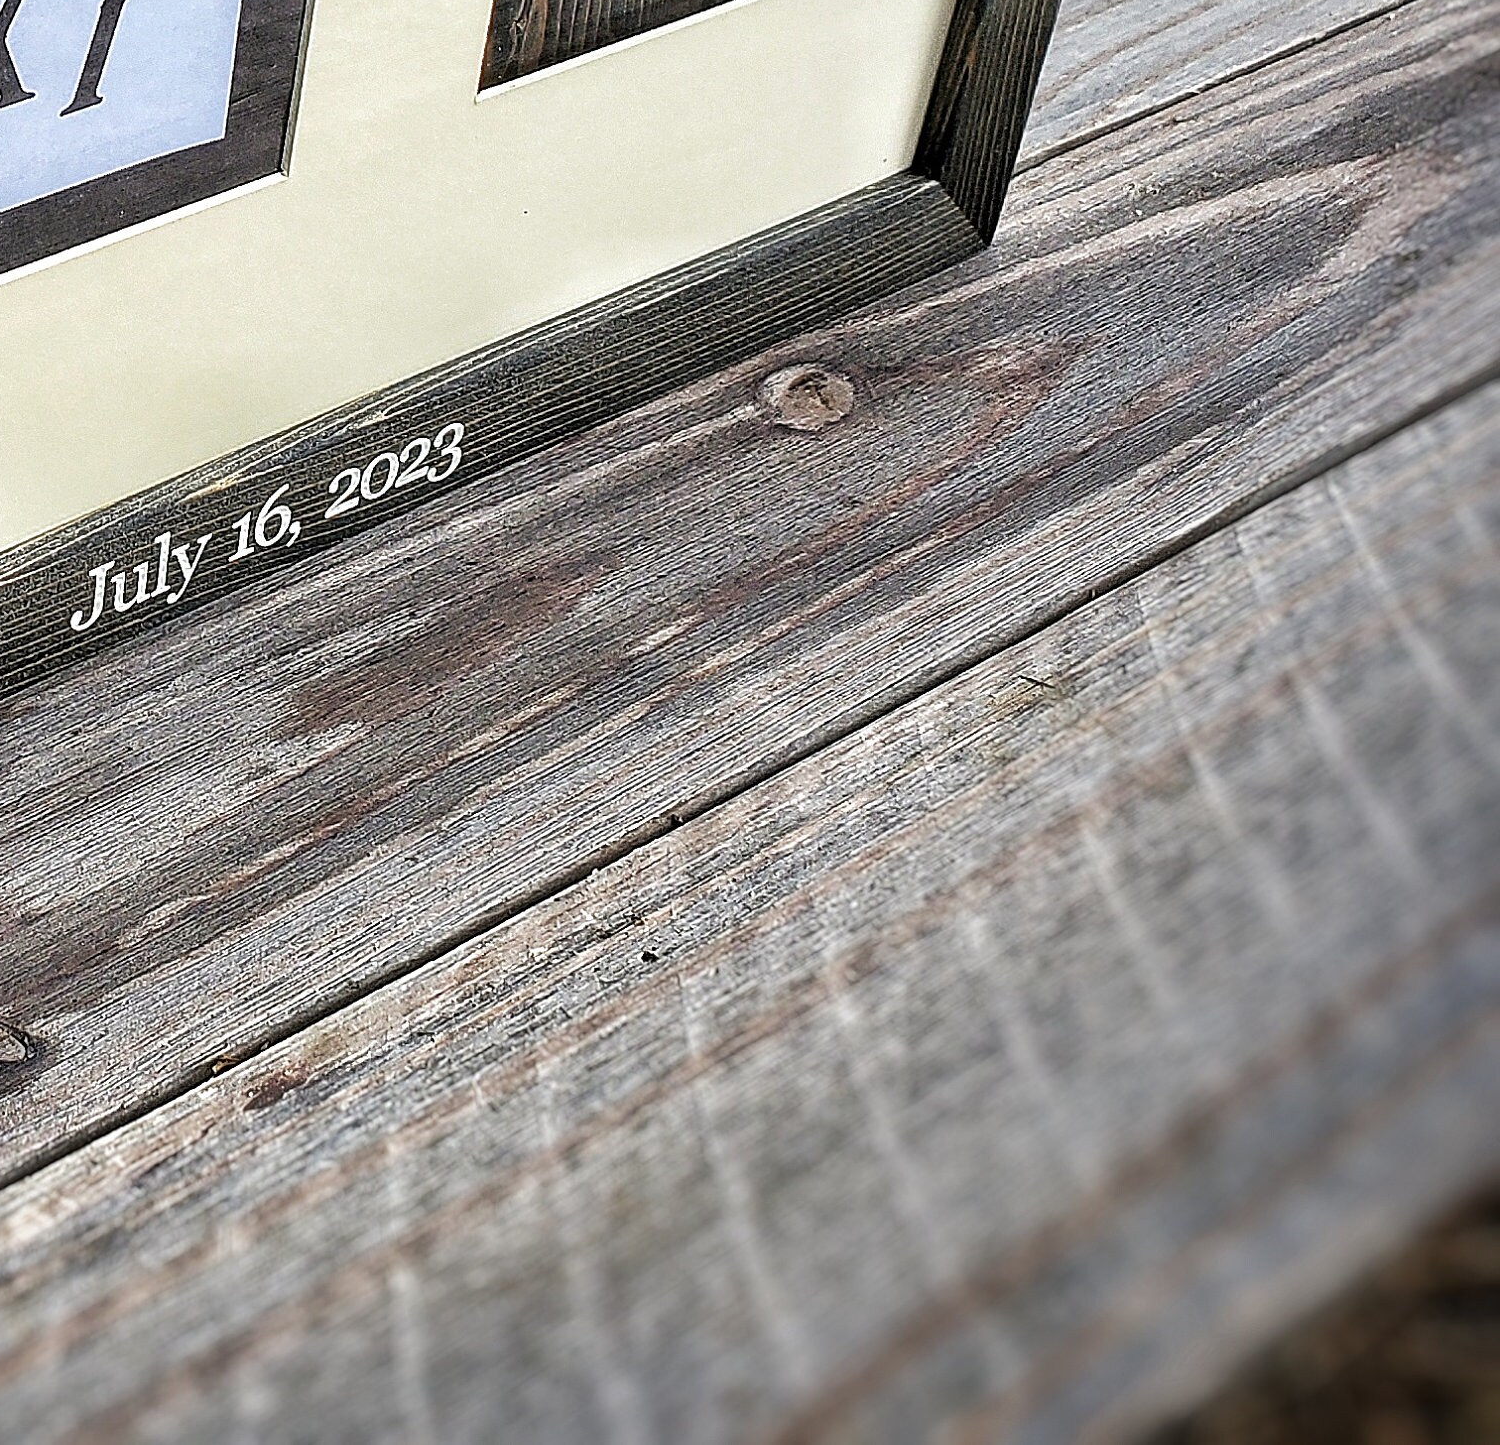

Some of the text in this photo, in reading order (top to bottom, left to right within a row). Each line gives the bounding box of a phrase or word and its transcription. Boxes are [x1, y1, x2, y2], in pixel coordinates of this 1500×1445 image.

[69, 421, 466, 632] July 16, 2023
